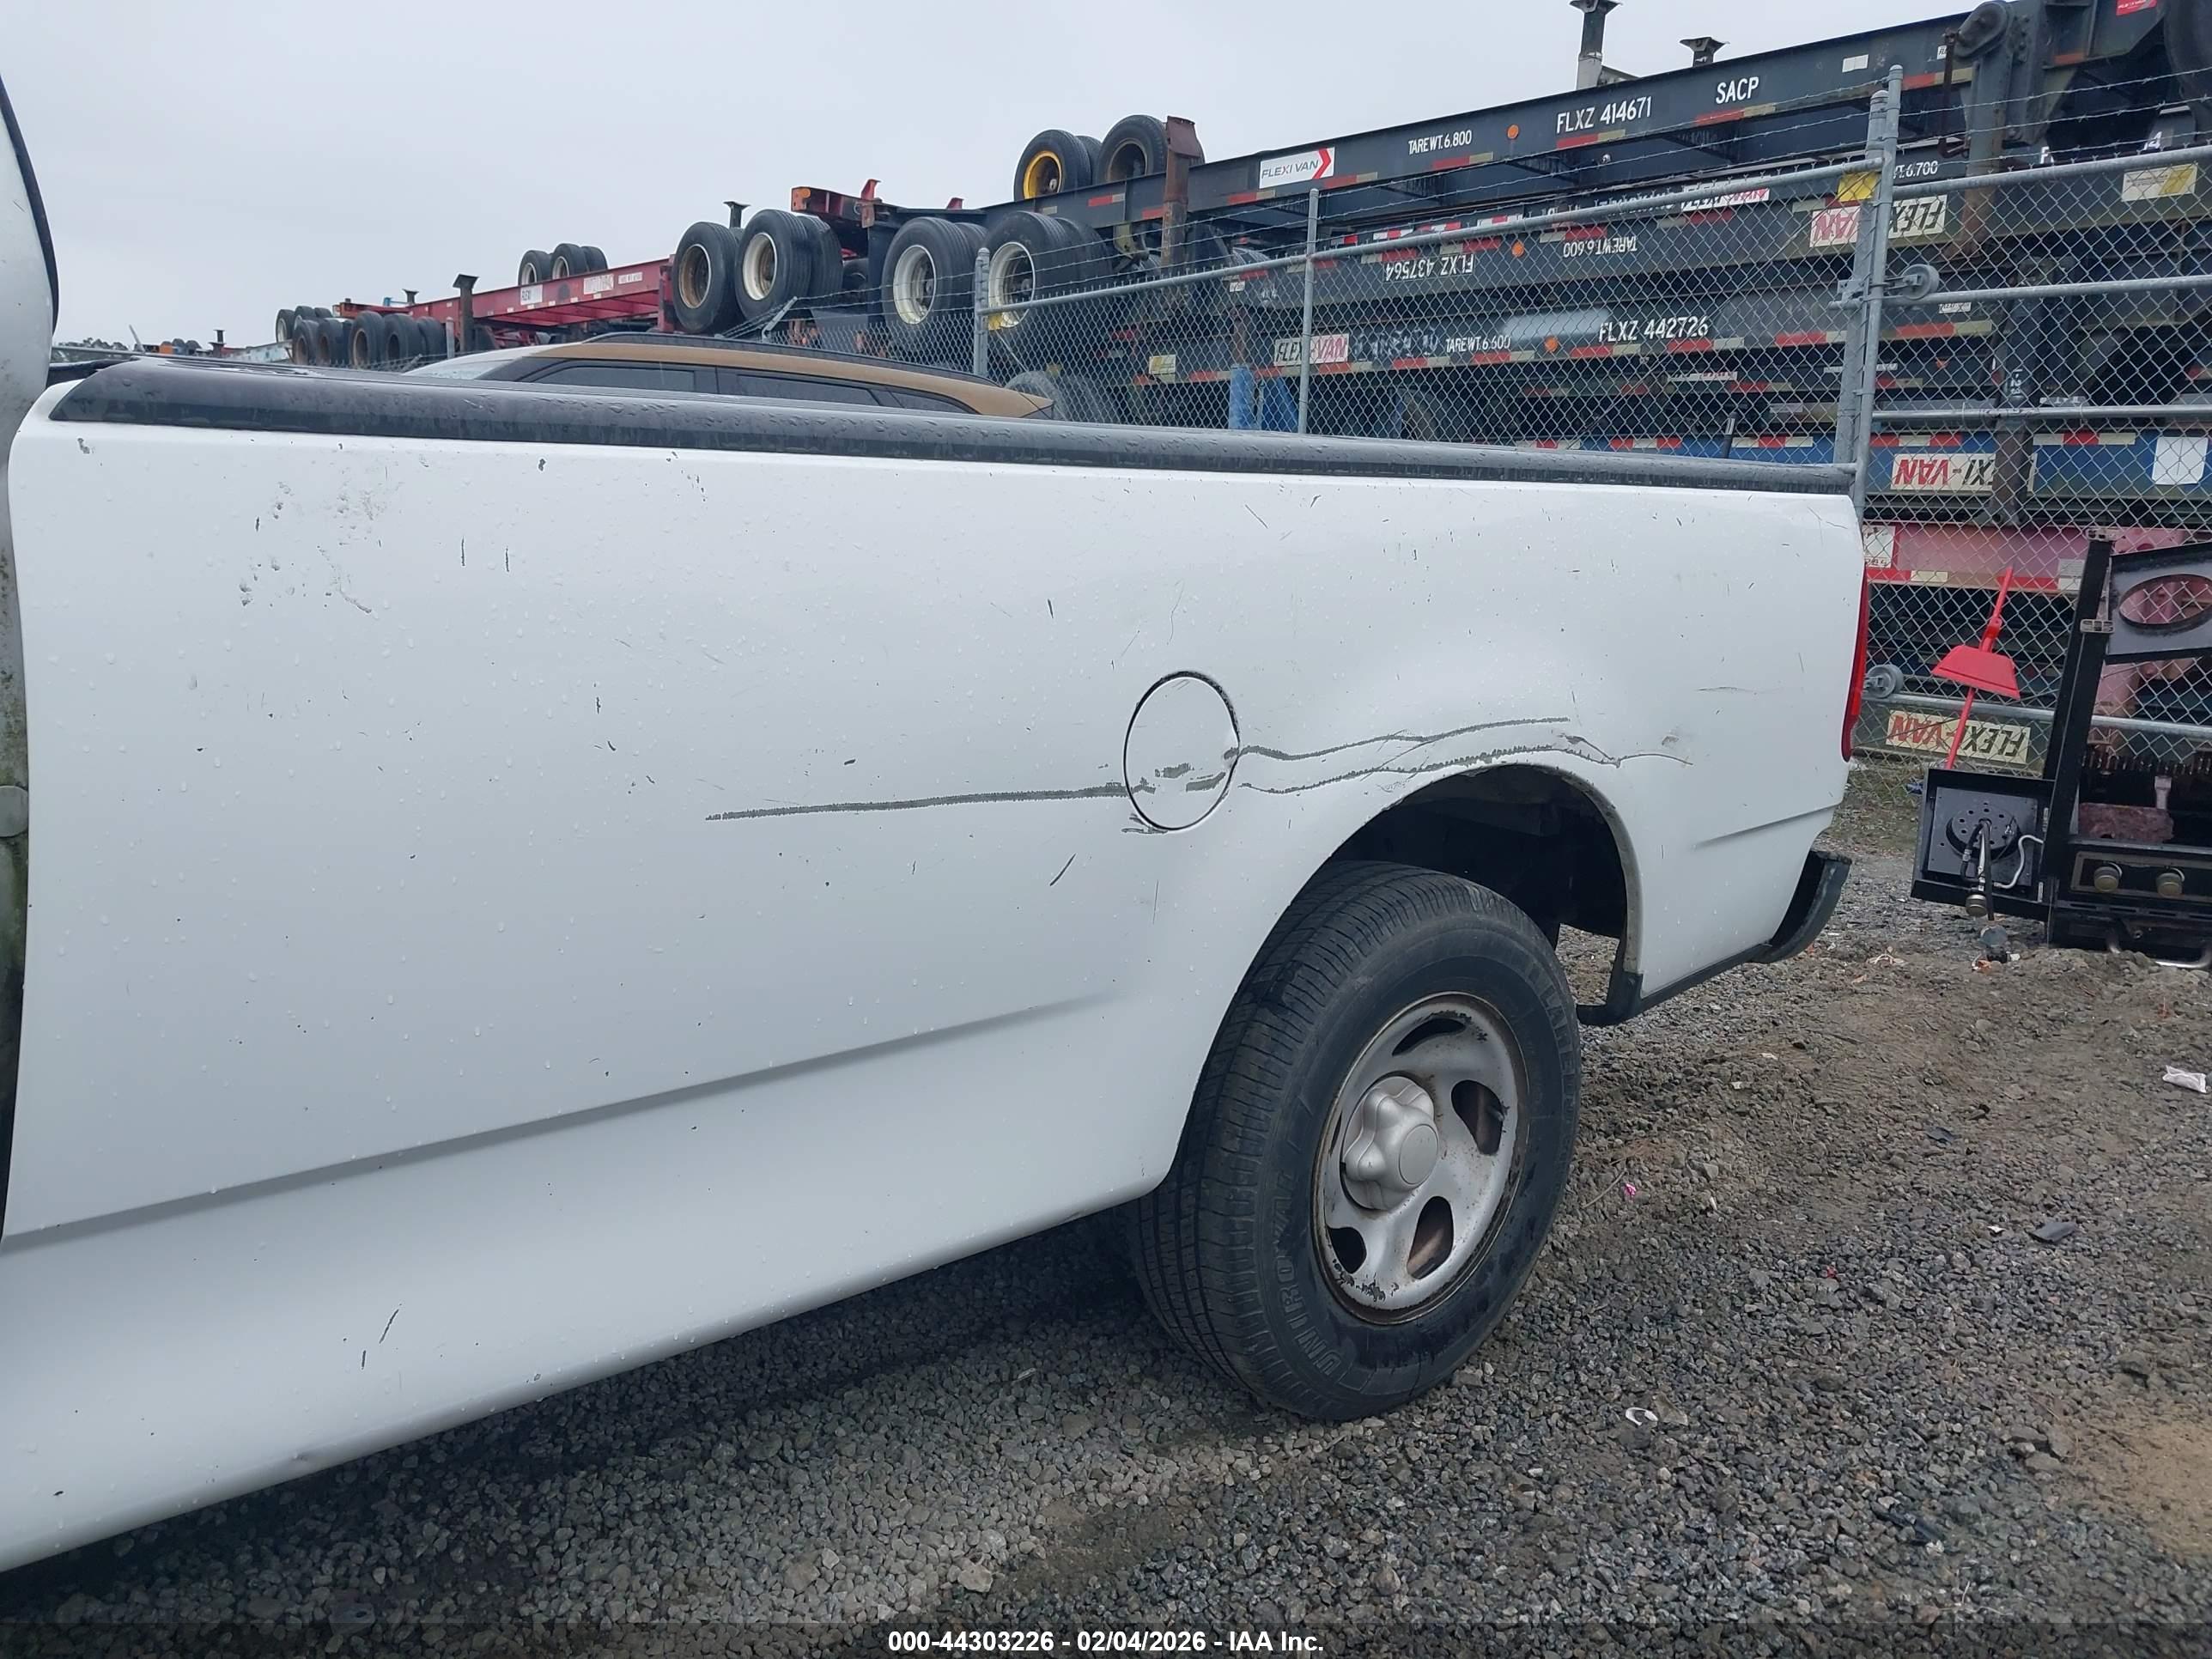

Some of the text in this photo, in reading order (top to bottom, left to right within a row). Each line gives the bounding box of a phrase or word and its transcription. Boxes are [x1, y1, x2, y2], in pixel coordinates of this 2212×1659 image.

[1715, 76, 1759, 105] SACP
[1556, 95, 1652, 134] FLXZ 414671
[1261, 160, 1319, 179] FLEXI VAN
[1384, 255, 1474, 282] FLXZ 437564
[1598, 315, 1709, 343] FLXZ 442726
